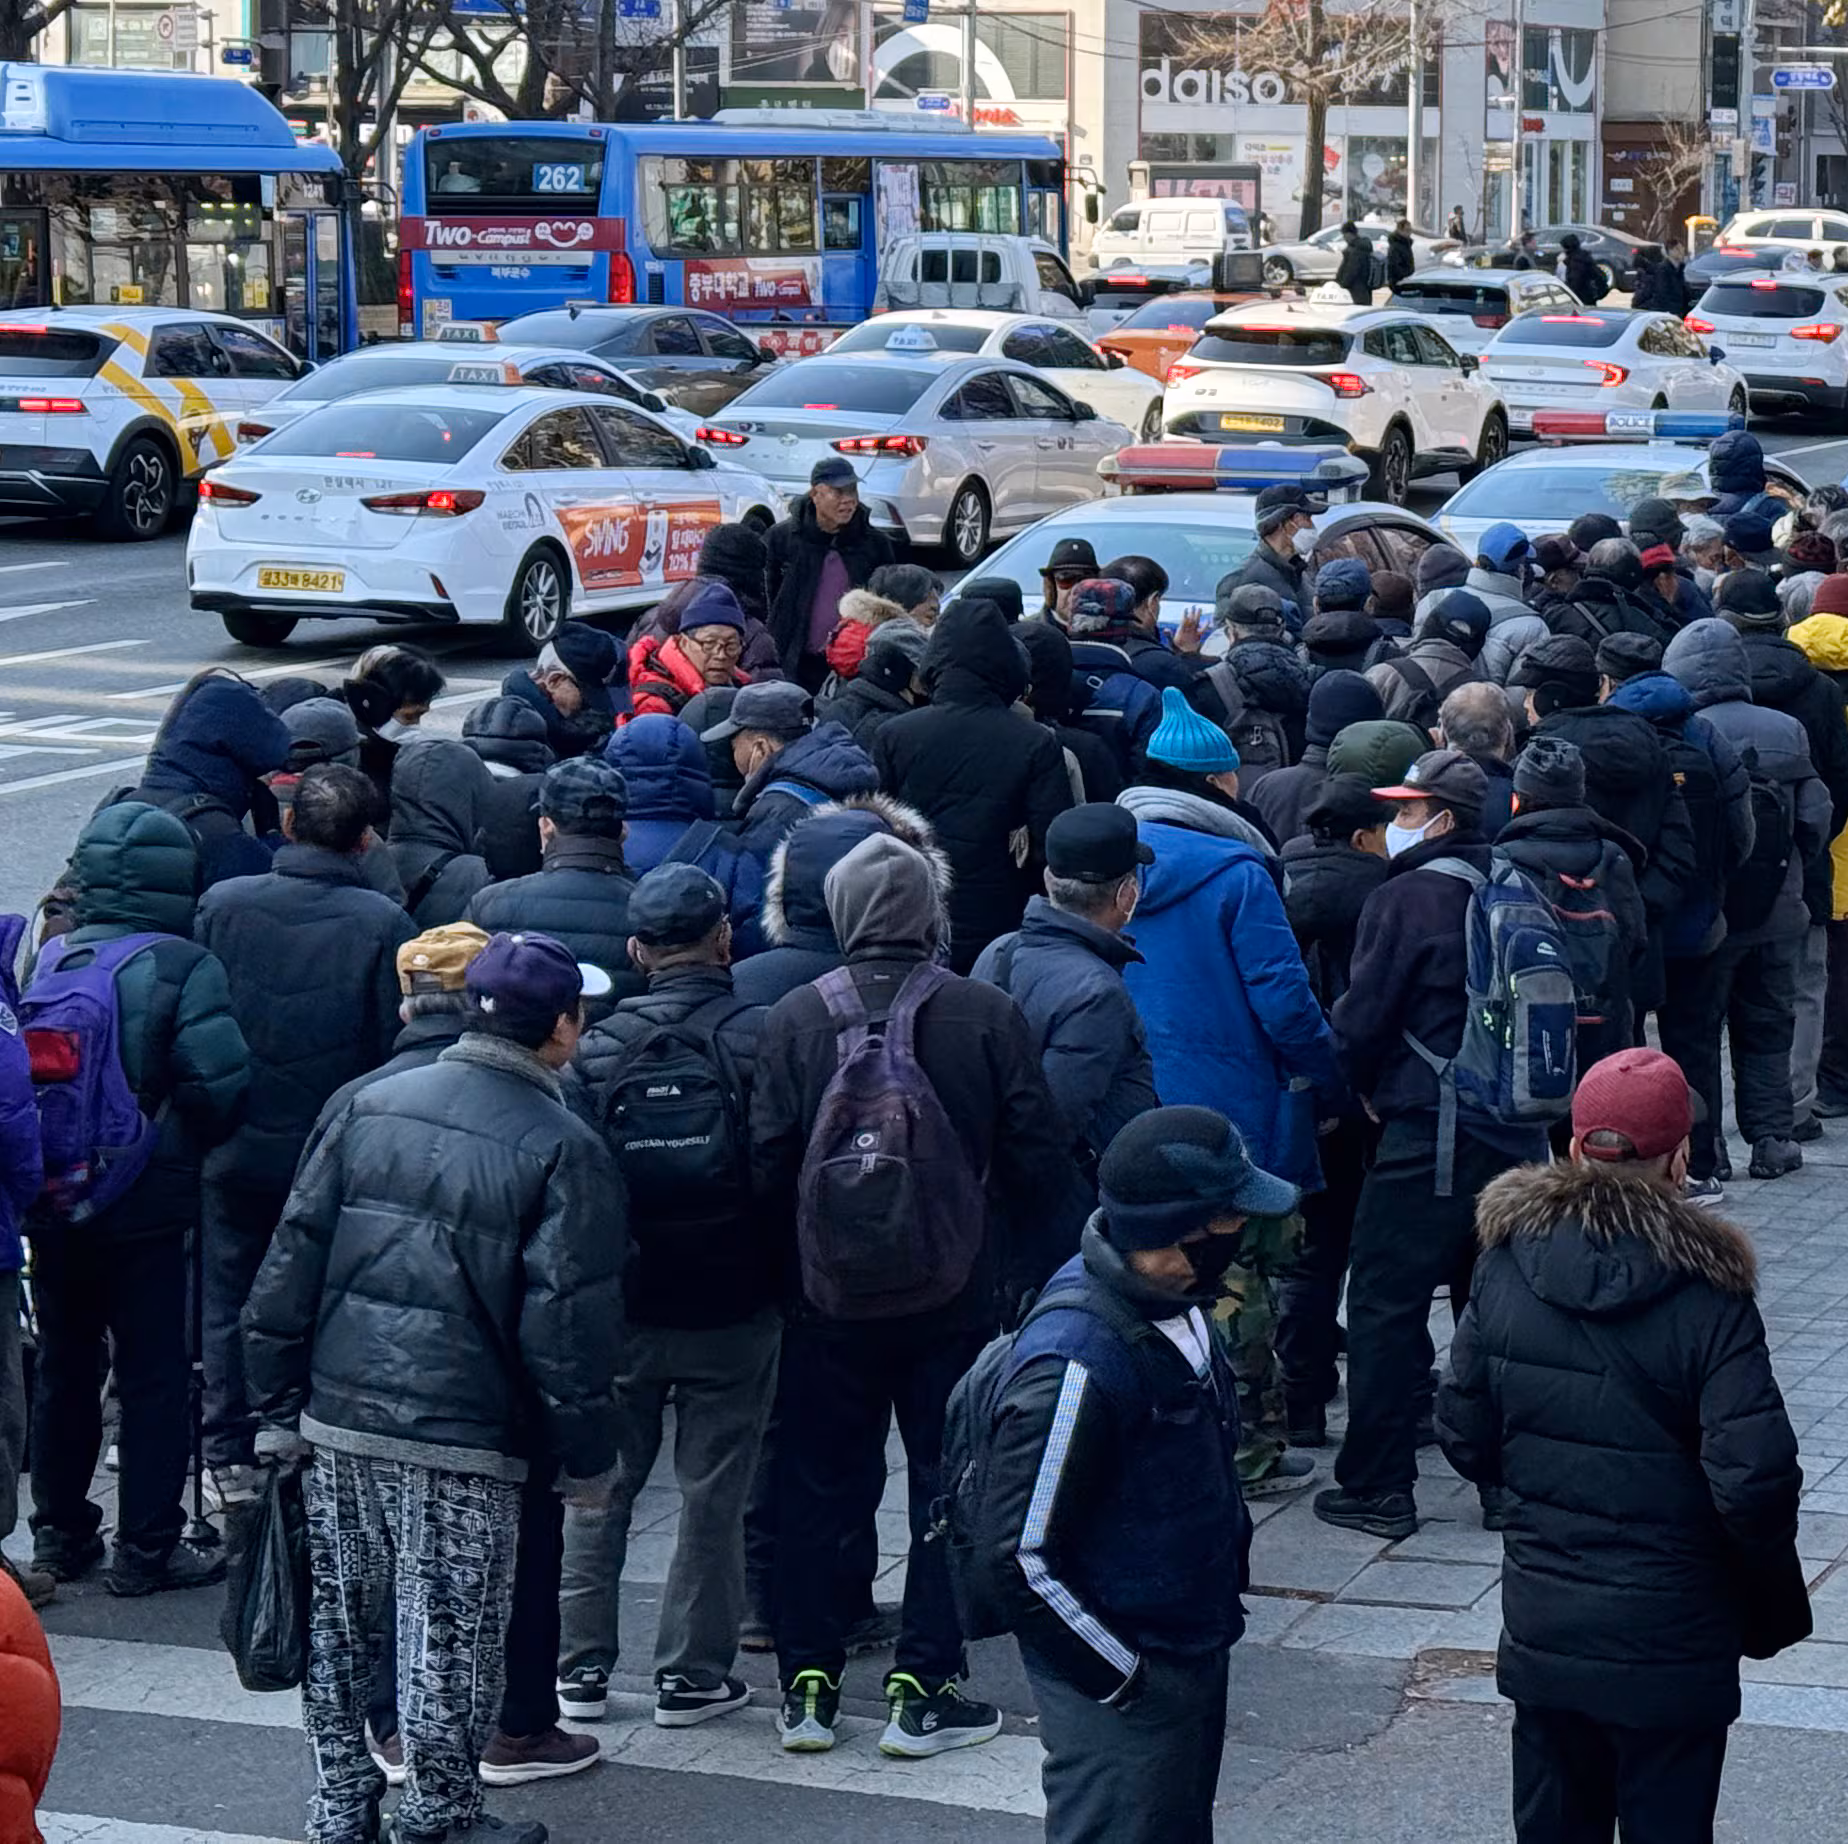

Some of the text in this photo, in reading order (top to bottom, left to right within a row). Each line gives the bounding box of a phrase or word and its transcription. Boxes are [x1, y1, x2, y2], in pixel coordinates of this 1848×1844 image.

[1141, 55, 1286, 105] daiso
[538, 166, 580, 190] 262
[689, 271, 750, 302] 중부대학교
[445, 329, 477, 339] TAXI
[459, 369, 496, 380] TAXI
[1610, 416, 1650, 428] POLICE
[668, 553, 689, 571] 10%
[625, 1135, 711, 1150] CONTAIN YOURSELF
